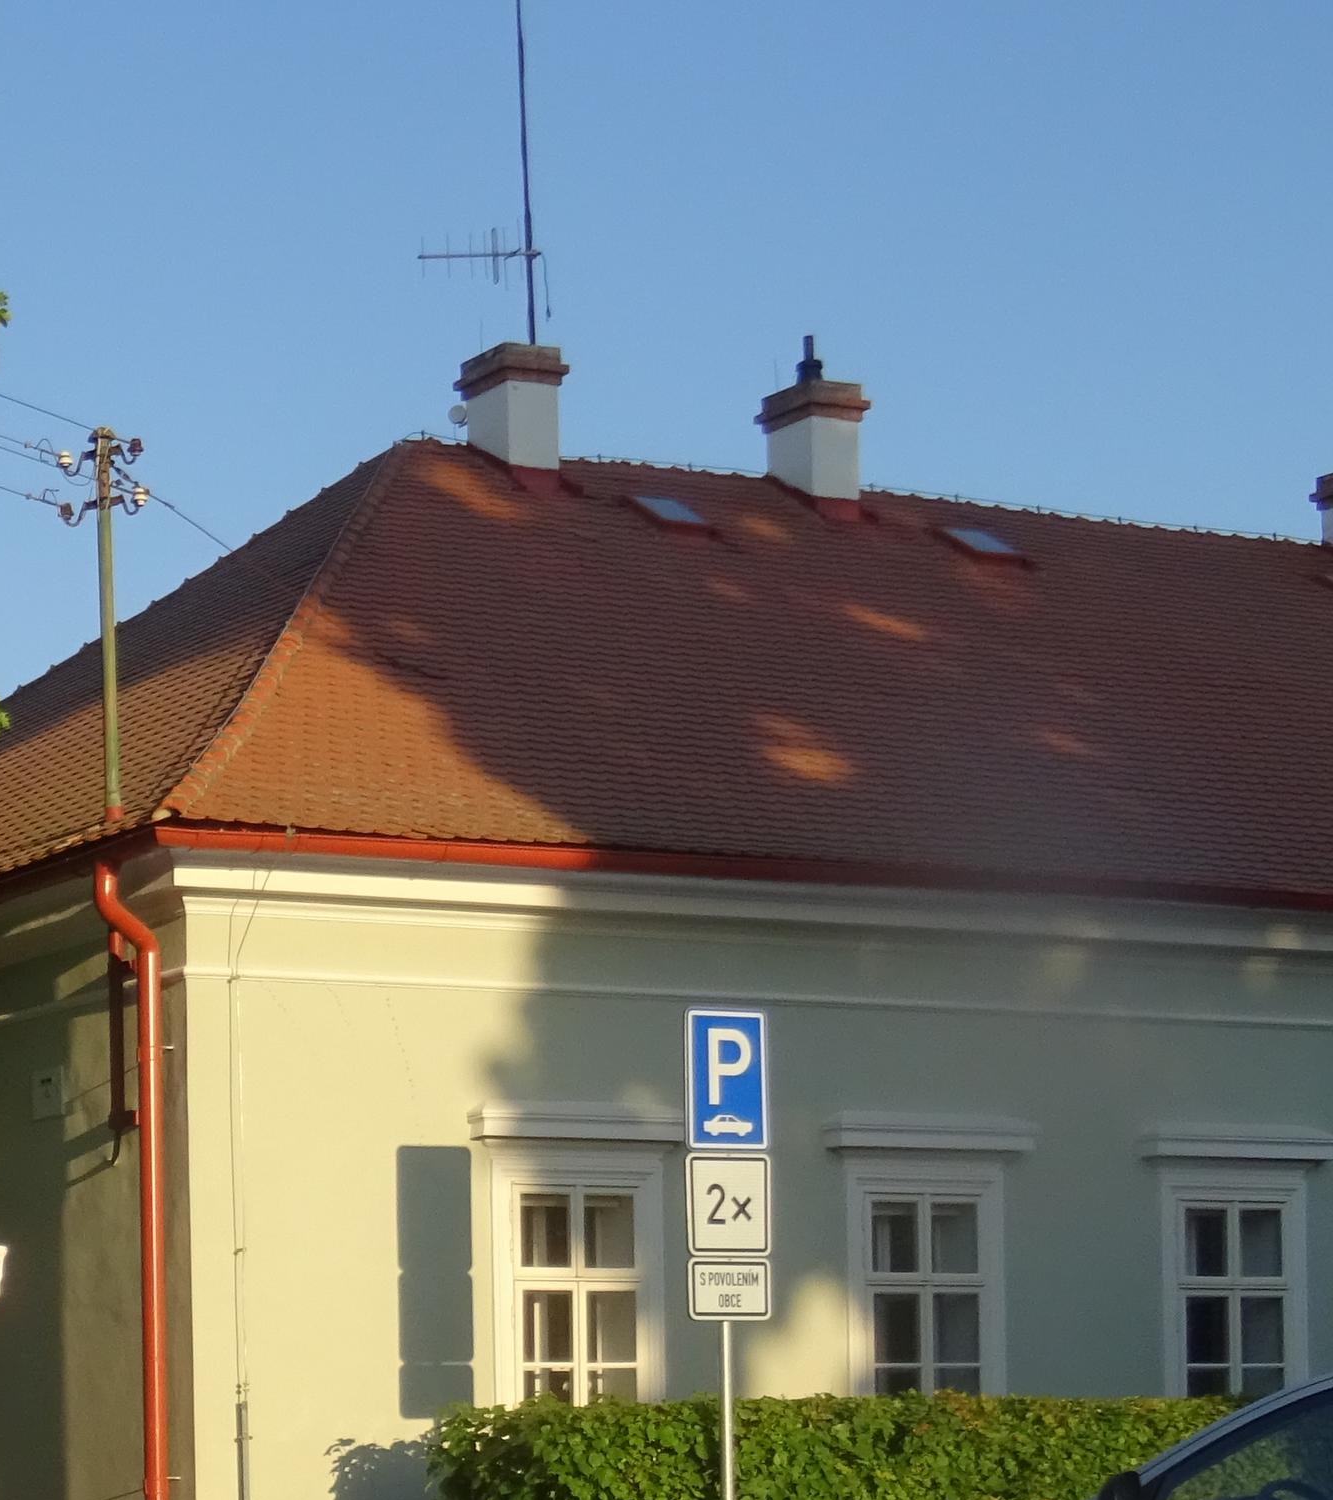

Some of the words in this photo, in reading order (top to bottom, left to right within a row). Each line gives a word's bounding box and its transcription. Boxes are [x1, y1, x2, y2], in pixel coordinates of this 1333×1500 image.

[708, 1028, 751, 1105] P
[700, 1272, 706, 1286] S
[708, 1269, 759, 1287] POVOLENÍM
[718, 1294, 742, 1308] OBCE
